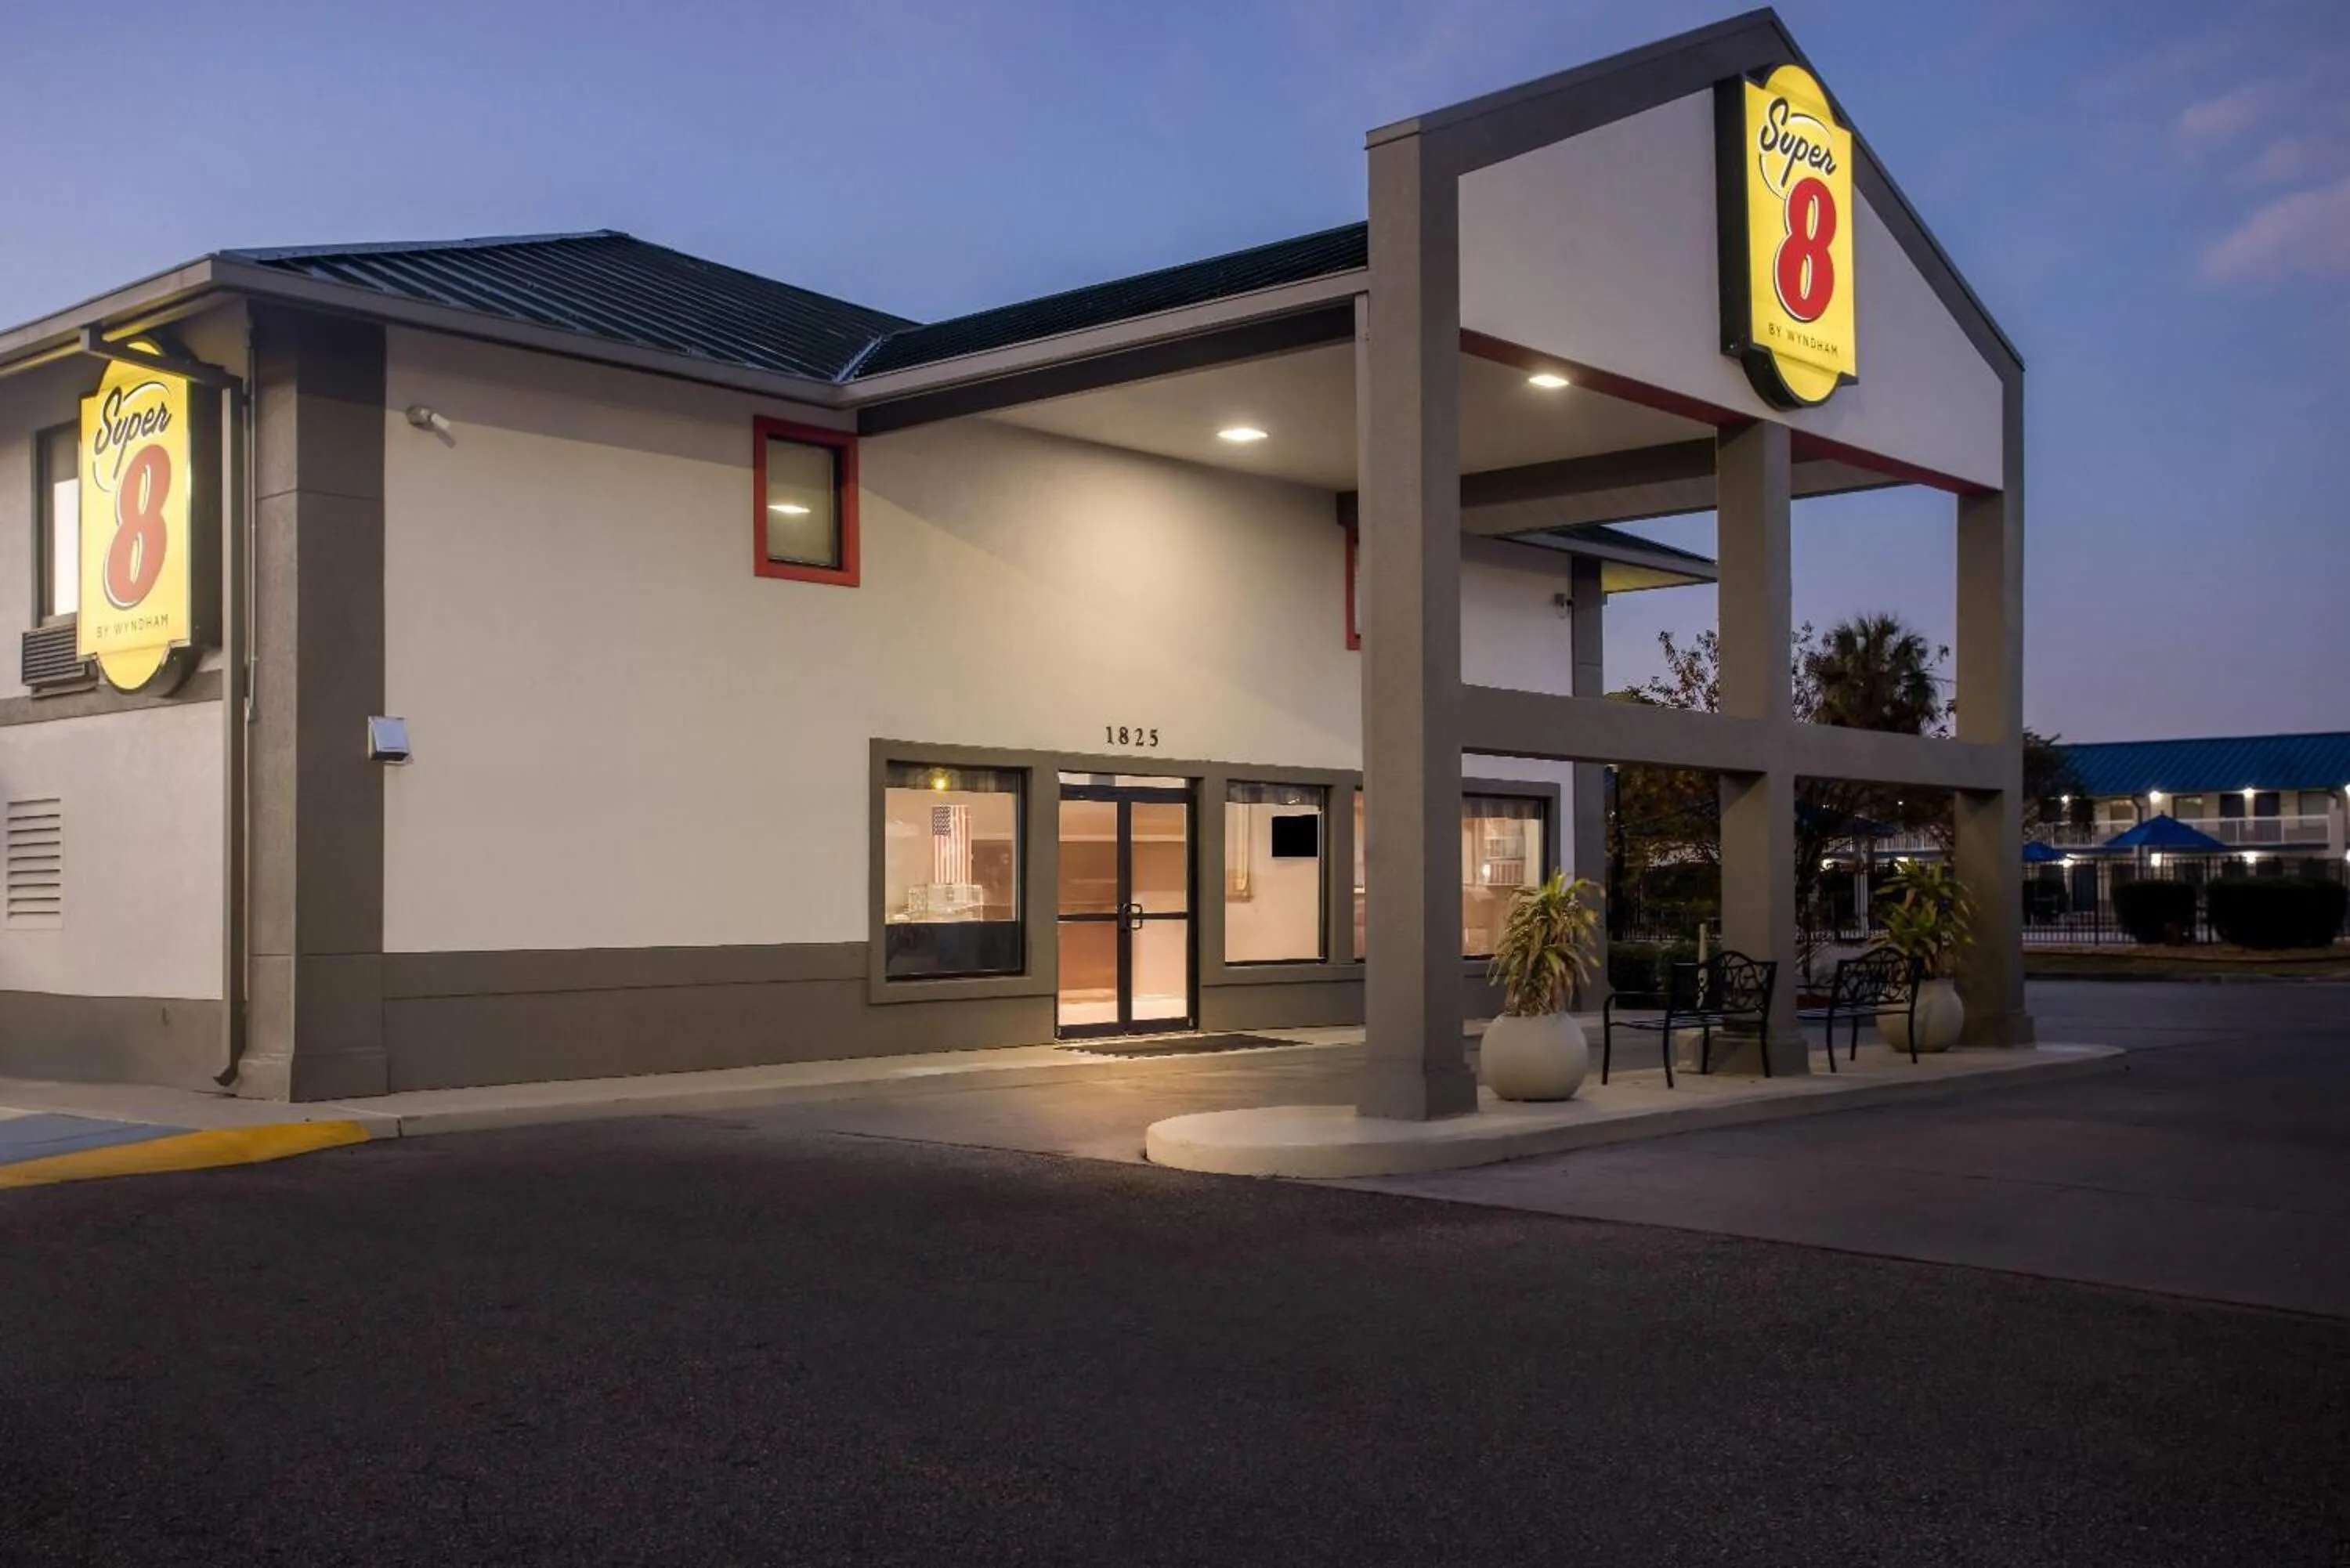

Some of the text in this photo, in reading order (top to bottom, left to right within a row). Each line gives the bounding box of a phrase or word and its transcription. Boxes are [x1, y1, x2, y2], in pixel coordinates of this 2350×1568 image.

[1759, 97, 1837, 188] Super
[1773, 177, 1837, 323] 8
[1769, 323, 1838, 356] BY WYNDHAM
[95, 386, 172, 479] Super
[103, 444, 172, 610] 8
[96, 613, 169, 638] BY WYNDHAM
[1105, 726, 1159, 747] 1825
